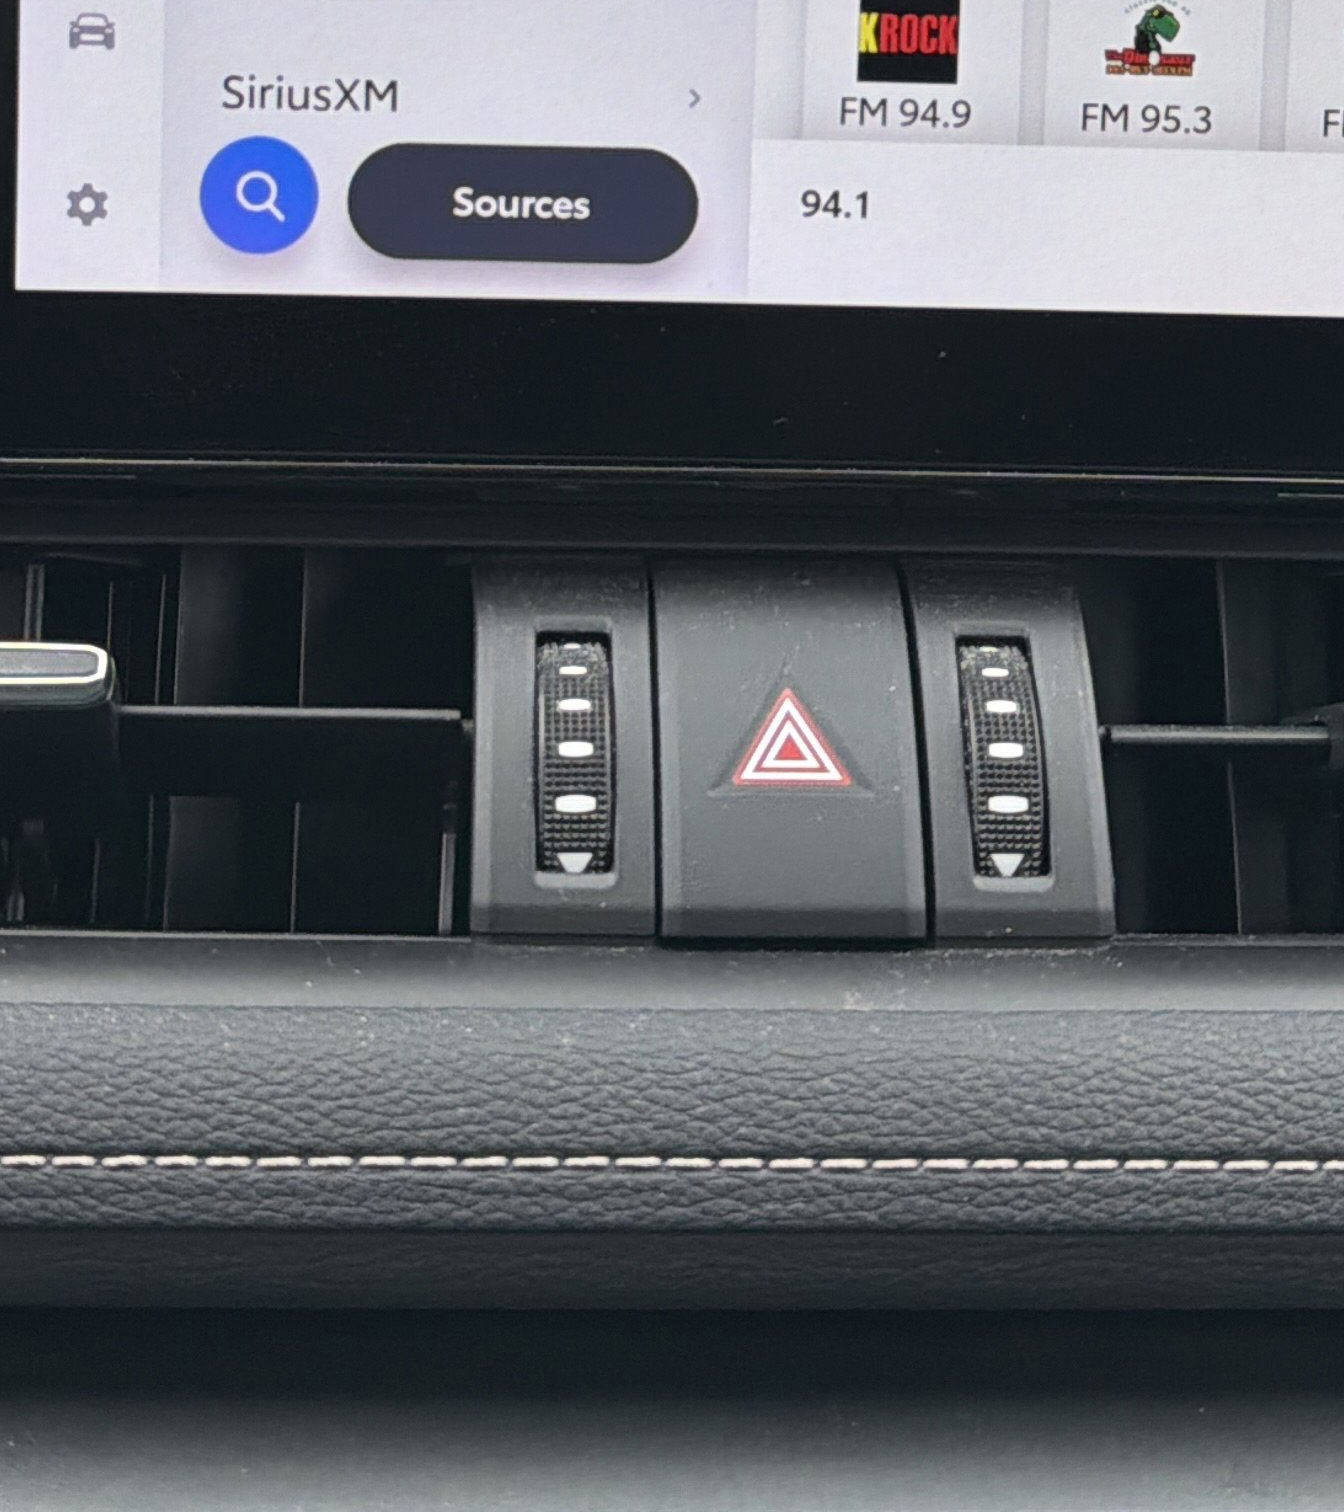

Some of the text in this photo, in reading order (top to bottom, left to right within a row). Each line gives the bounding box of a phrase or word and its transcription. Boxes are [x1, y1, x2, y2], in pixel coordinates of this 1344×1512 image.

[858, 12, 959, 55] KROCK
[221, 74, 398, 113] SiriusXM
[839, 96, 972, 129] FM 94.9
[1081, 102, 1212, 135] FM 95.3
[452, 186, 591, 220] Sources
[801, 189, 868, 219] 94.1
